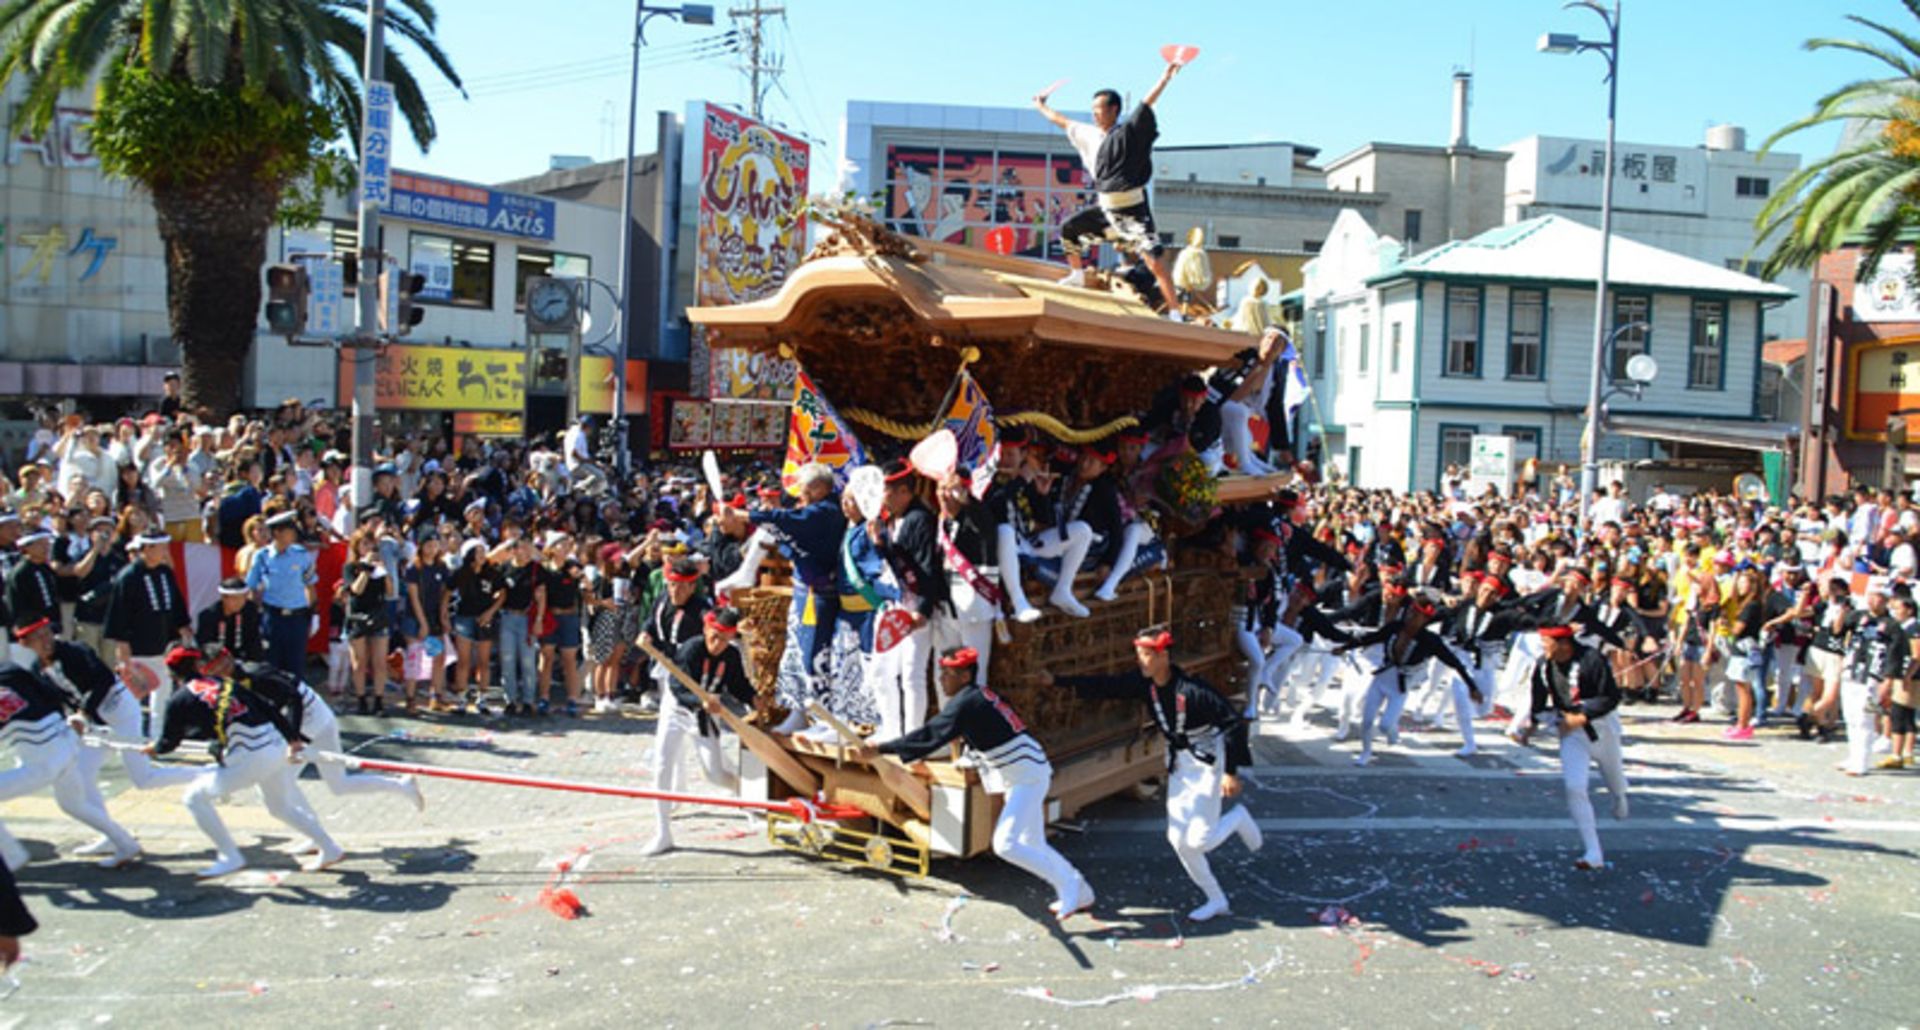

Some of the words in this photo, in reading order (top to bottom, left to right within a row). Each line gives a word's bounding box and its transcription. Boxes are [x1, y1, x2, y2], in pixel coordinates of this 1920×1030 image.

[365, 85, 390, 201] 歩車分離式
[490, 208, 545, 236] Axis
